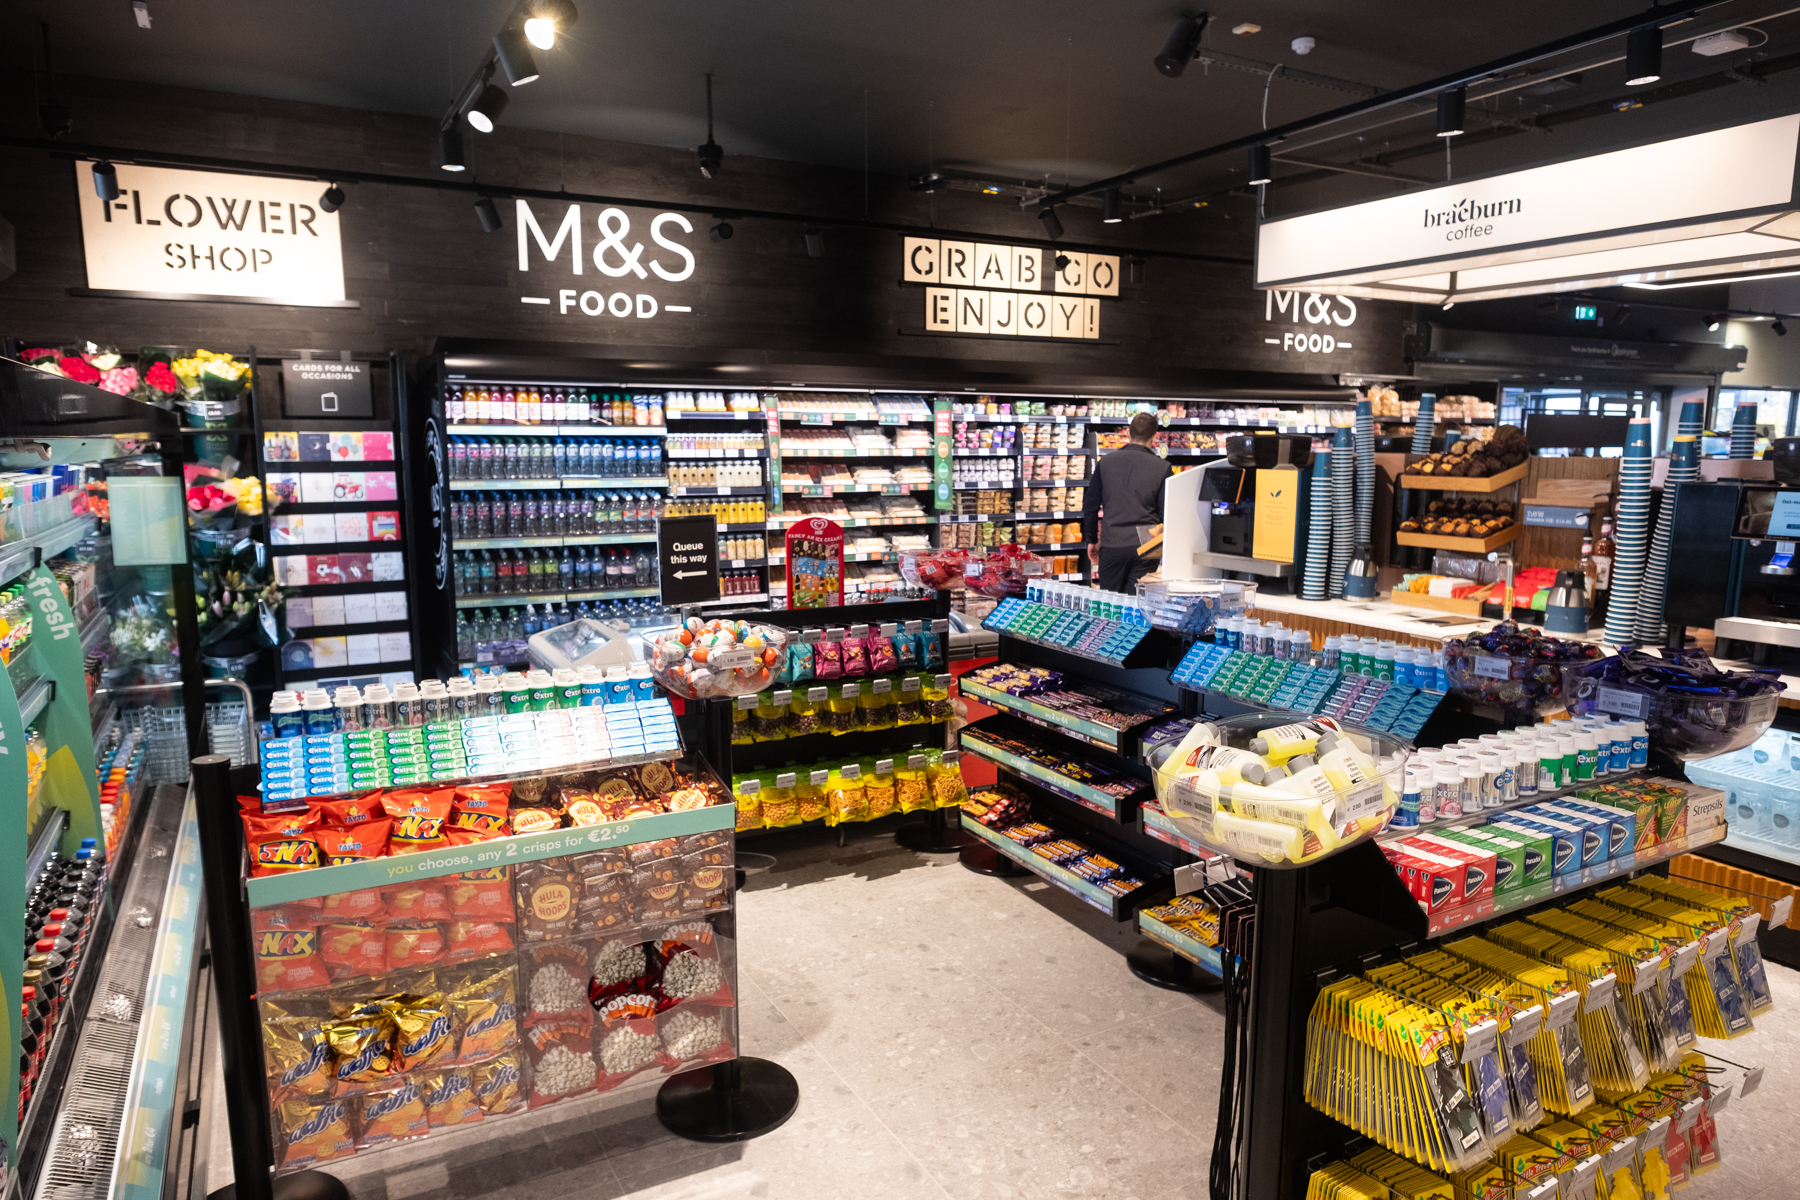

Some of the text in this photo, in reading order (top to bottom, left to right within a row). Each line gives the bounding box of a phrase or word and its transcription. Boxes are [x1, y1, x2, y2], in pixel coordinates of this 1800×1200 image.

[103, 189, 320, 237] FLOWER
[1446, 224, 1494, 241] coffee
[516, 199, 695, 282] M&S
[164, 242, 273, 274] SHOP
[910, 244, 1114, 289] GRAB GO
[559, 289, 659, 319] FOOD
[1266, 290, 1358, 327] M&S
[933, 294, 1096, 334] ENJOY!
[1284, 333, 1335, 354] FOOD
[292, 364, 361, 373] CARDS FOR ALL
[301, 372, 353, 380] OCCASIONS
[672, 542, 704, 551] Queue
[670, 554, 707, 564] this way
[1415, 668, 1433, 676] extra
[533, 691, 553, 700] extra
[582, 687, 601, 695] extra
[427, 702, 449, 711] extra
[457, 699, 477, 709] extra
[1061, 716, 1068, 724] €4
[427, 723, 447, 731] extra
[347, 732, 368, 740] extra
[387, 731, 408, 739] extra
[427, 733, 448, 741] extra
[266, 741, 287, 749] extra
[307, 736, 329, 745] extra
[308, 746, 330, 754] extra
[348, 741, 369, 750] extra
[428, 742, 449, 751] extra
[266, 751, 288, 759] extra
[349, 751, 370, 760] extra
[389, 747, 410, 755] extra
[266, 760, 288, 769] extra
[308, 756, 330, 764] extra
[391, 757, 412, 765] extra
[352, 761, 373, 769] extra
[267, 770, 290, 779] extra
[310, 766, 332, 775] extra
[311, 776, 333, 784] extra
[352, 771, 374, 780] extra
[267, 781, 290, 789] extra
[353, 780, 374, 789] extra
[393, 776, 414, 785] extra
[1063, 780, 1070, 788] €4
[310, 786, 333, 794] extra
[268, 791, 291, 800] extra
[408, 805, 429, 813] TAYTO
[577, 806, 595, 816] HULA
[1692, 799, 1723, 817] Strepsils
[344, 815, 366, 824] TAYTO
[520, 814, 544, 828] HULA
[1612, 831, 1627, 840] Panadol
[338, 843, 362, 851] TAYTO
[1585, 840, 1600, 849] Panadol
[260, 841, 318, 864] SNAX
[387, 864, 414, 878] you
[418, 855, 474, 871] choose,
[478, 849, 502, 861] any
[506, 843, 518, 857] 2
[522, 838, 562, 855] crisps
[564, 835, 584, 847] for
[1557, 847, 1572, 857] Panadol
[1525, 854, 1542, 866] Panadol
[1496, 863, 1513, 875] Panadol
[697, 869, 722, 885] HOOPS
[1466, 873, 1485, 885] Panadol
[1533, 872, 1549, 880] ActiFast
[1503, 880, 1520, 889] ActiFast
[1433, 884, 1451, 895] Panadol
[1482, 886, 1493, 894] Extra
[539, 890, 564, 904] HULA
[538, 902, 568, 917] HOOPS
[653, 921, 714, 953] popcorn
[1420, 1032, 1445, 1061] Little Trees
[1642, 1106, 1656, 1118] Trees
[1595, 1126, 1623, 1152] Little Trees
[1558, 1144, 1588, 1170] Little Trees
[1517, 1158, 1552, 1187] Little Trees
